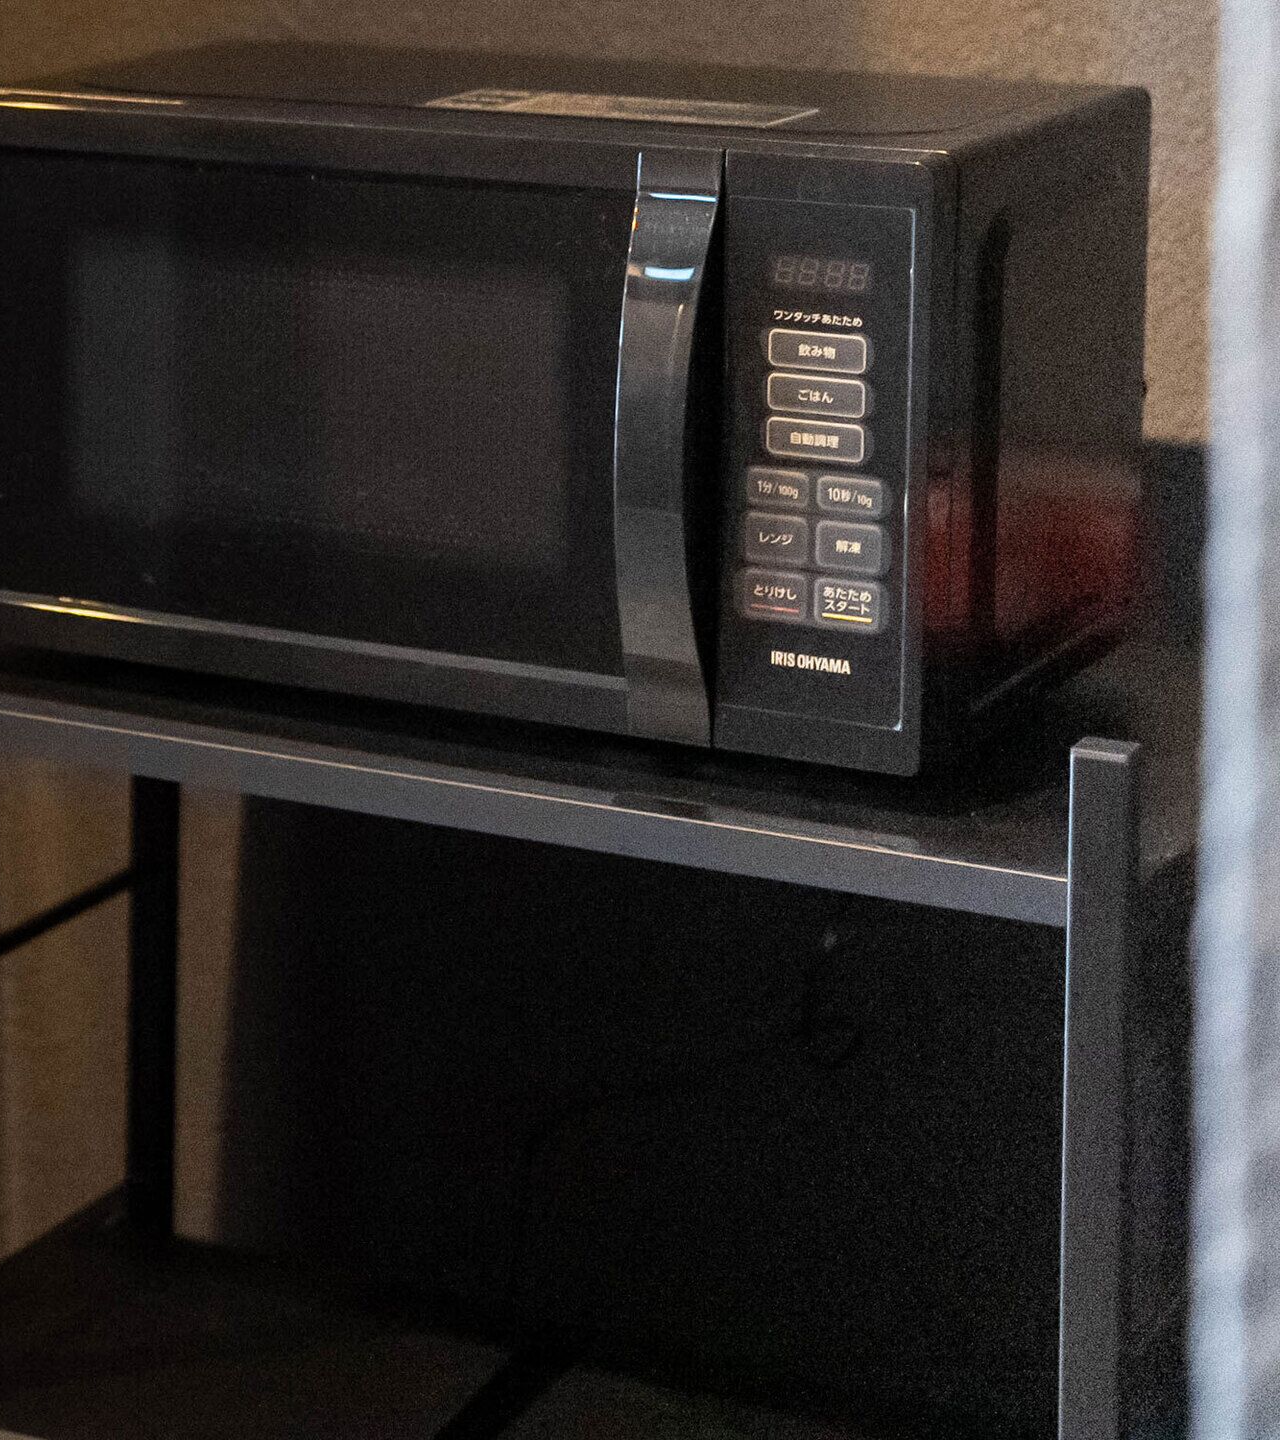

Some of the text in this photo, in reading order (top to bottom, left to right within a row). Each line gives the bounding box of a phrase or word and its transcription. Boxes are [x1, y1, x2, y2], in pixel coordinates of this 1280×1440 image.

[773, 310, 863, 328] ワンタッチあたため
[798, 343, 836, 360] 飲み物
[798, 389, 834, 404] ごはん
[790, 431, 839, 449] 自動調理
[827, 487, 873, 507] 10秒/10g
[759, 531, 793, 545] レンジ
[835, 539, 862, 554] 解凍
[753, 584, 797, 600] とりけし
[823, 586, 872, 602] あたため
[824, 599, 870, 615] スタート
[770, 650, 851, 675] IRIS OHYAMA
